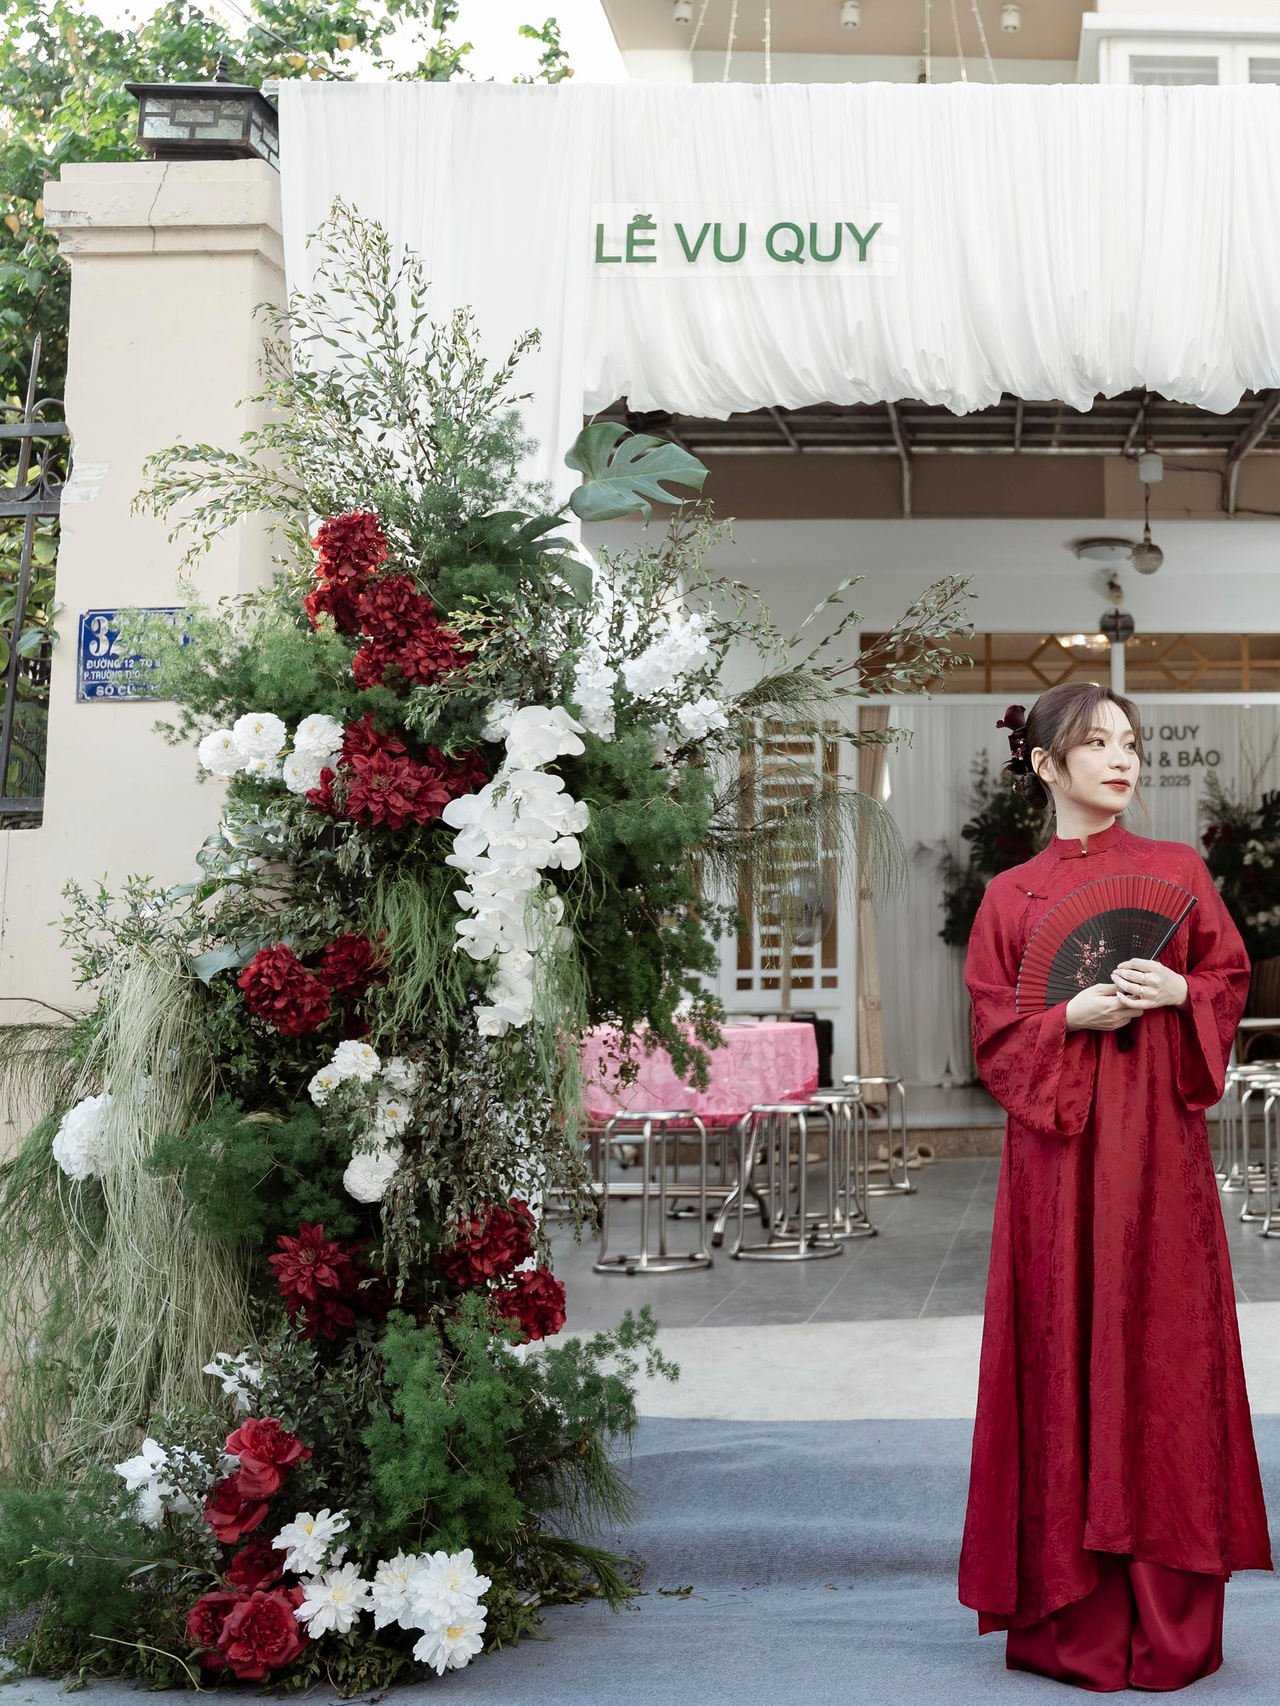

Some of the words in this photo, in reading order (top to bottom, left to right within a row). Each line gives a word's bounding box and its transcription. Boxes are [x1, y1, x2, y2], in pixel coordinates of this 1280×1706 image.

[595, 213, 658, 263] LỄ
[673, 223, 747, 263] VU
[765, 222, 883, 265] QUY
[124, 659, 134, 669] 12
[1141, 726, 1154, 741] U
[1159, 725, 1200, 741] QUY
[1159, 751, 1171, 767] &
[1160, 775, 1191, 787] 2025
